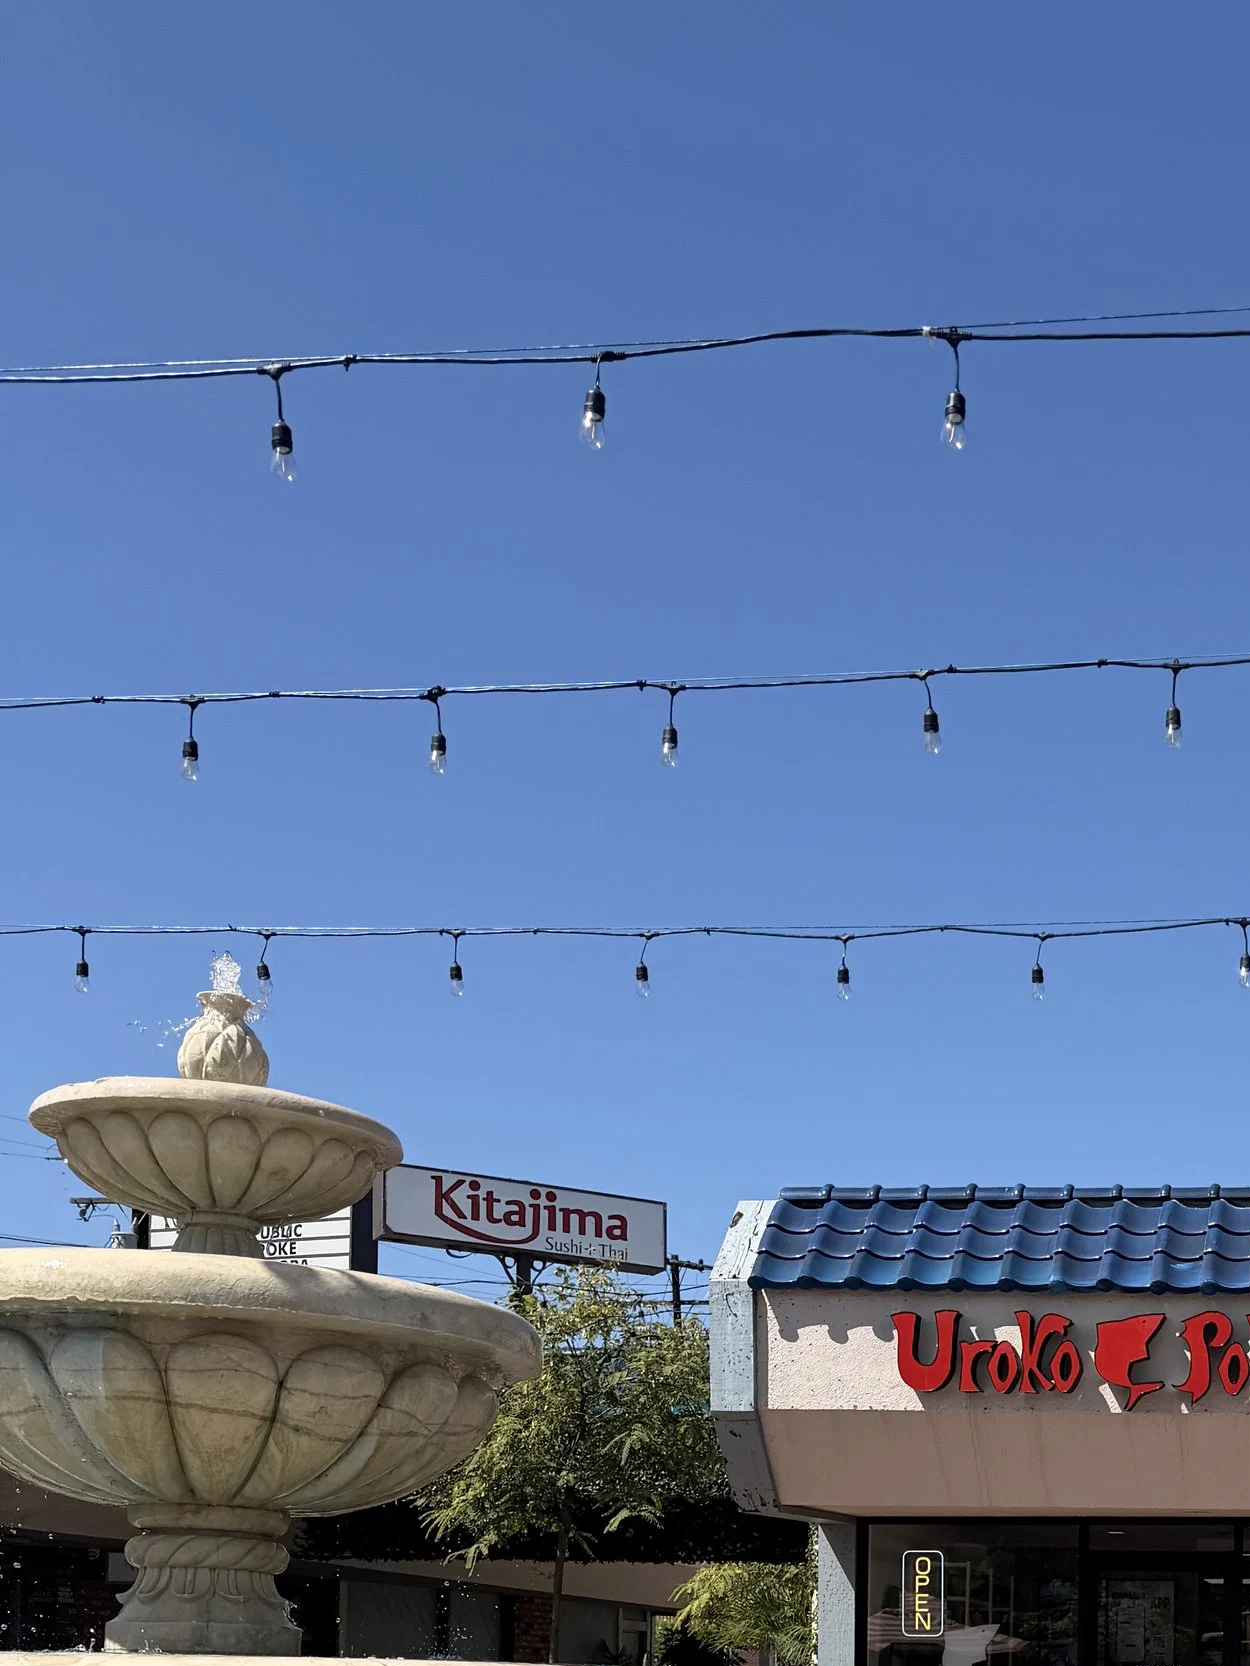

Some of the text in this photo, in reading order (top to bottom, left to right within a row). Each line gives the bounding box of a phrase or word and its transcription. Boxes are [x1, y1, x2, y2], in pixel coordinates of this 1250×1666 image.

[260, 1223, 303, 1239] UBLIC
[431, 1175, 628, 1245] Kitajima
[545, 1236, 582, 1255] Sushi
[598, 1243, 628, 1262] Thai
[915, 1556, 931, 1631] OPEN
